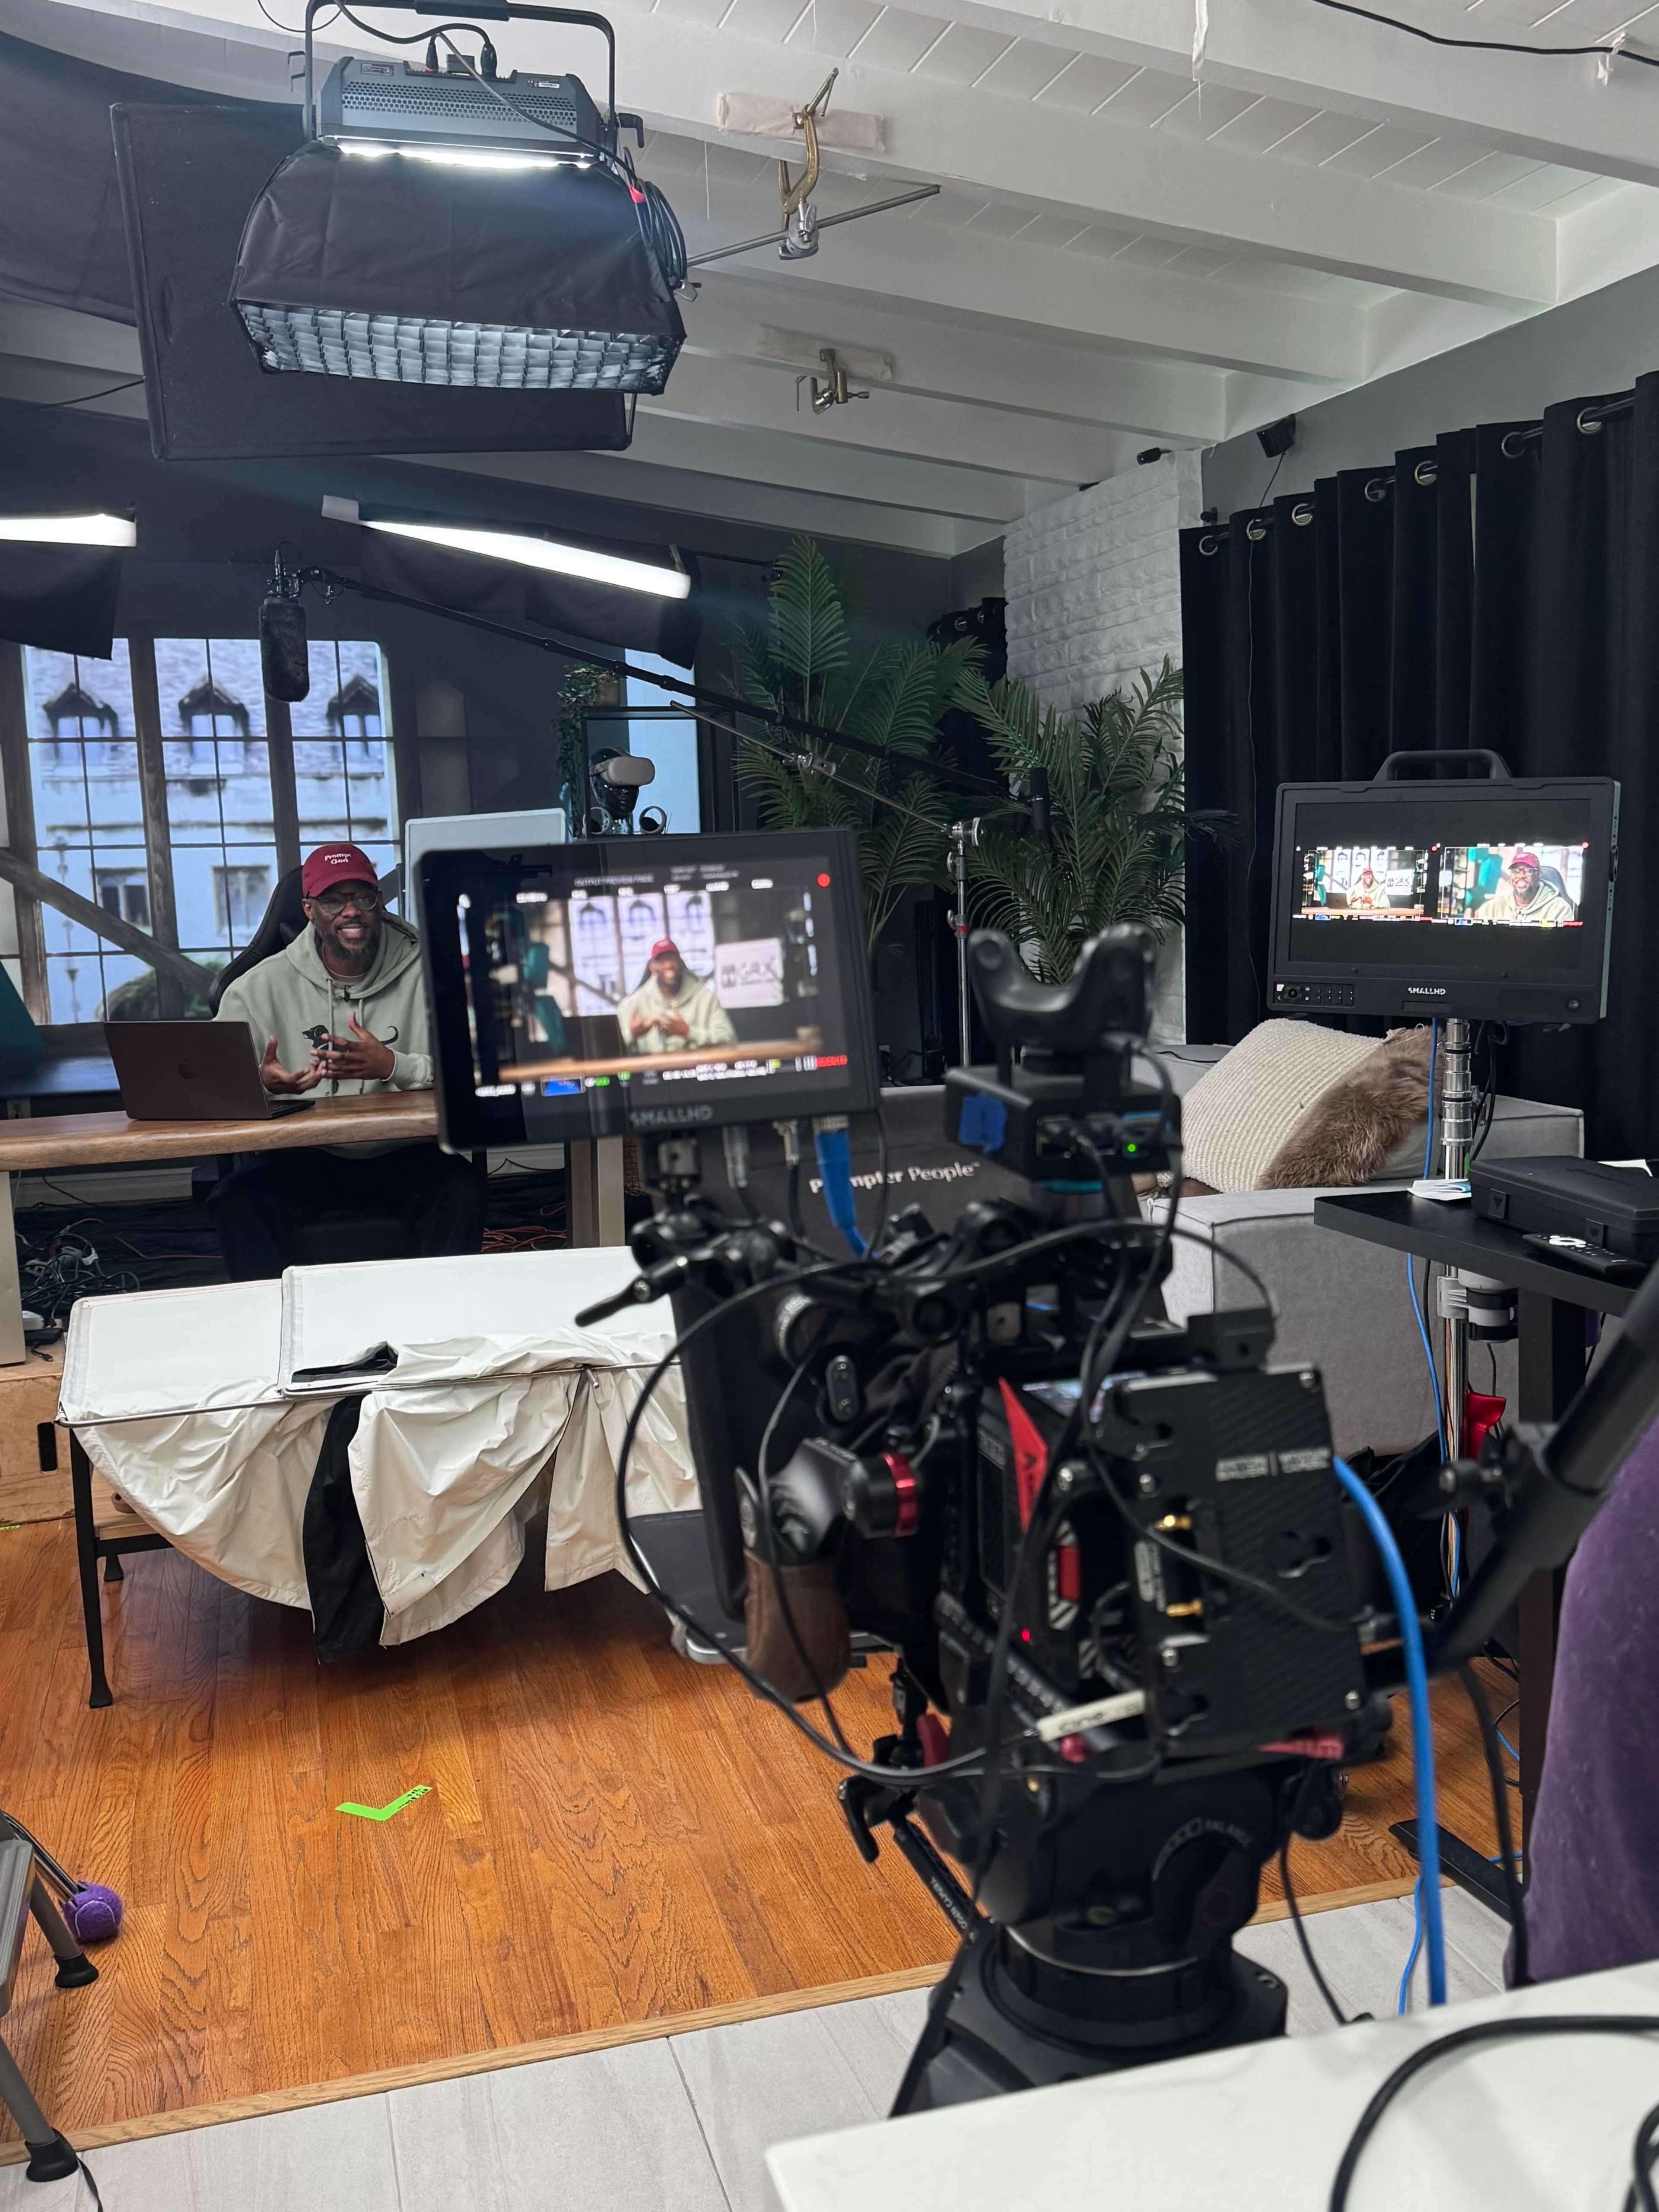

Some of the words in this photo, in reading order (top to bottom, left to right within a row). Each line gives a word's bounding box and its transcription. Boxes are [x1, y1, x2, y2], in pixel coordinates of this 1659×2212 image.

[1408, 987, 1446, 995] SMALLHD
[629, 1104, 713, 1127] SMALLHD
[809, 1170, 904, 1194] Pmpter
[908, 1161, 975, 1182] People
